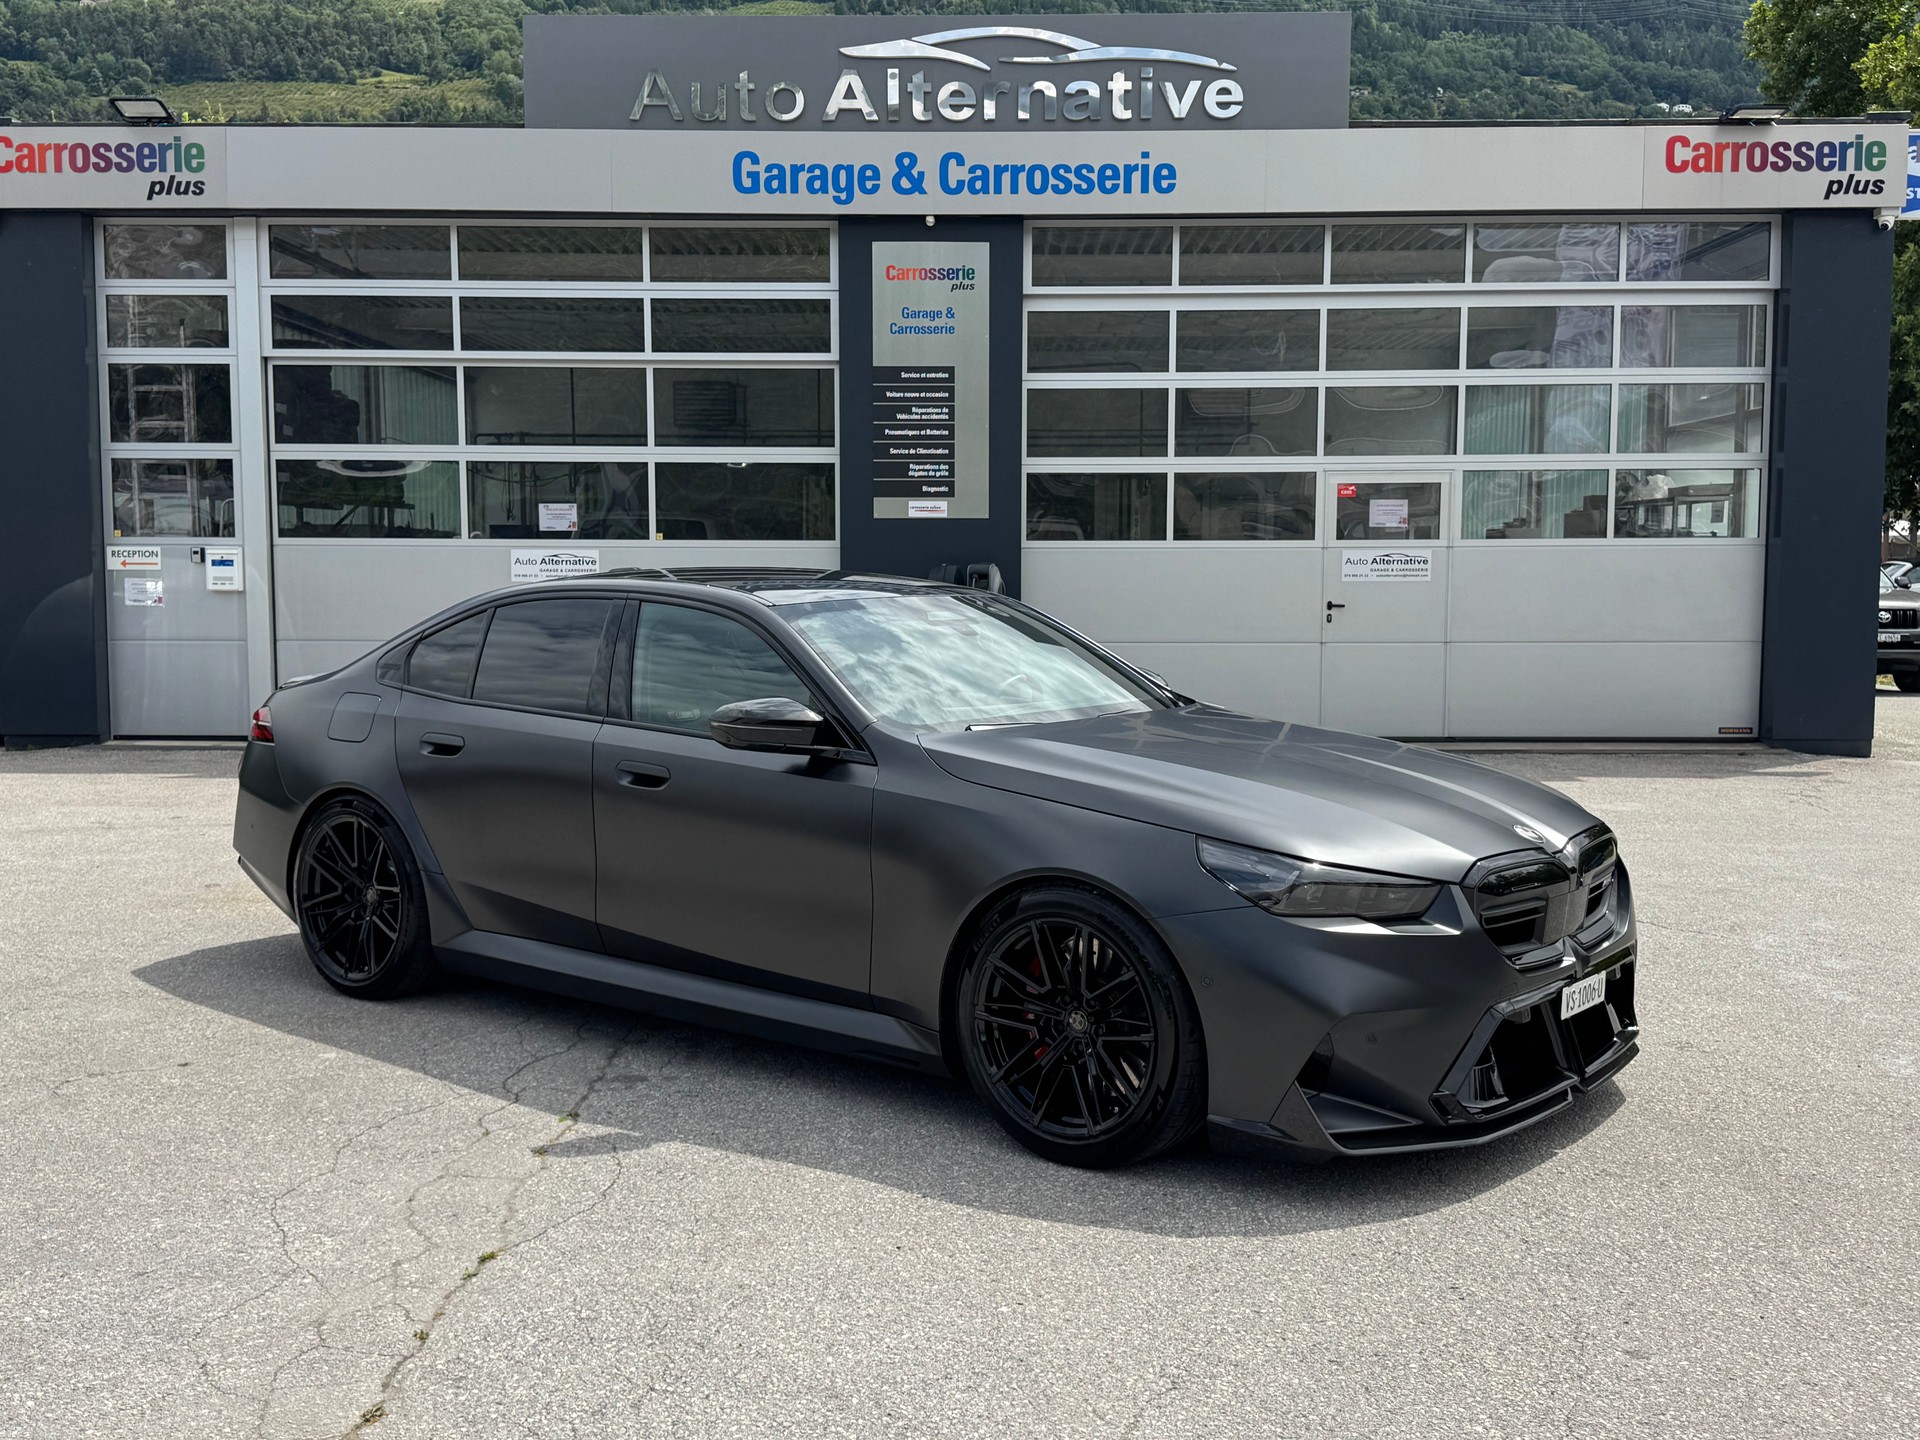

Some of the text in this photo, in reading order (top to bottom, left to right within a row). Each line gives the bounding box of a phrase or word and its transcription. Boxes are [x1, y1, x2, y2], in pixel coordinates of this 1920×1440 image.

[629, 66, 1244, 122] Auto Alternative
[0, 135, 206, 174] Carrosserie
[1665, 134, 1887, 174] Carrosserie
[732, 150, 1177, 206] Garage & Carrosserie
[1823, 173, 1886, 200] plus
[147, 175, 206, 201] plus
[885, 265, 976, 282] Carrosserie
[950, 281, 975, 292] plus
[901, 307, 955, 321] Garage &
[890, 322, 955, 335] Carrosserie
[111, 550, 158, 558] RECEPTION
[514, 557, 597, 566] Auto Alternative
[1345, 557, 1429, 566] Auto Alternative
